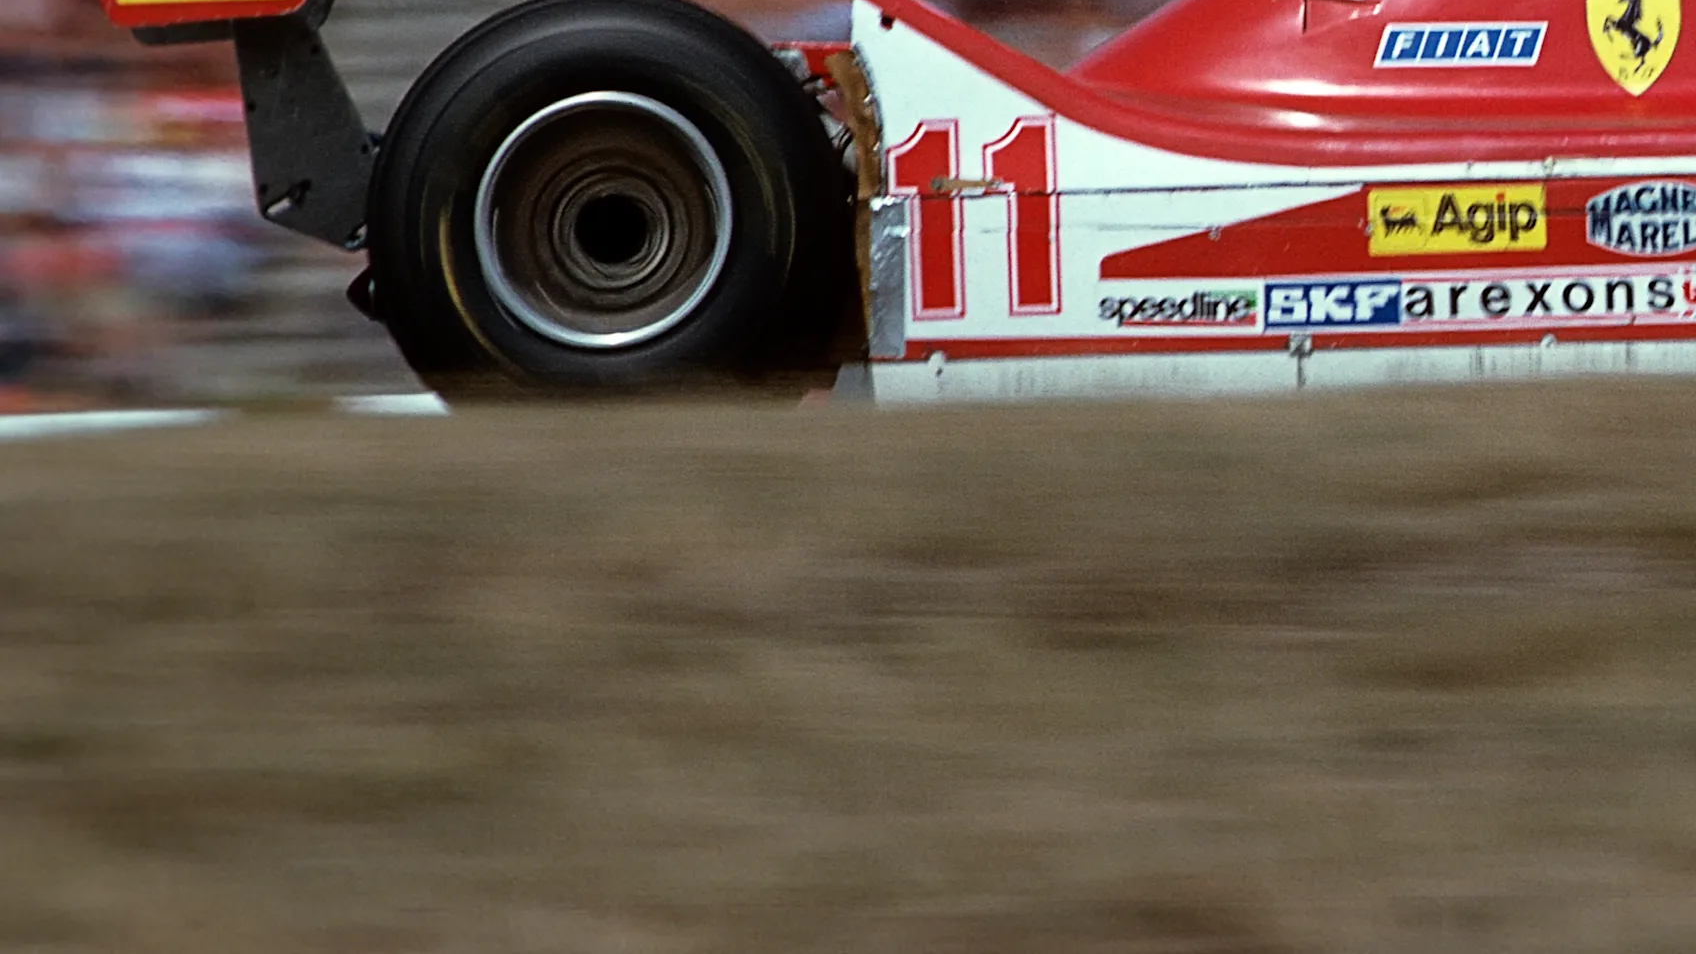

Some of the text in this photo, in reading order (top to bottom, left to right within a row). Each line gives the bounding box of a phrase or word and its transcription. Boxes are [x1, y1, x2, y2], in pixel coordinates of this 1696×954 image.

[1389, 26, 1532, 60] FIAT
[886, 114, 1060, 320] 11
[1430, 192, 1537, 246] Agip
[1098, 291, 1252, 327] speedline
[1267, 285, 1399, 325] SKF
[1404, 277, 1676, 319] arexons
